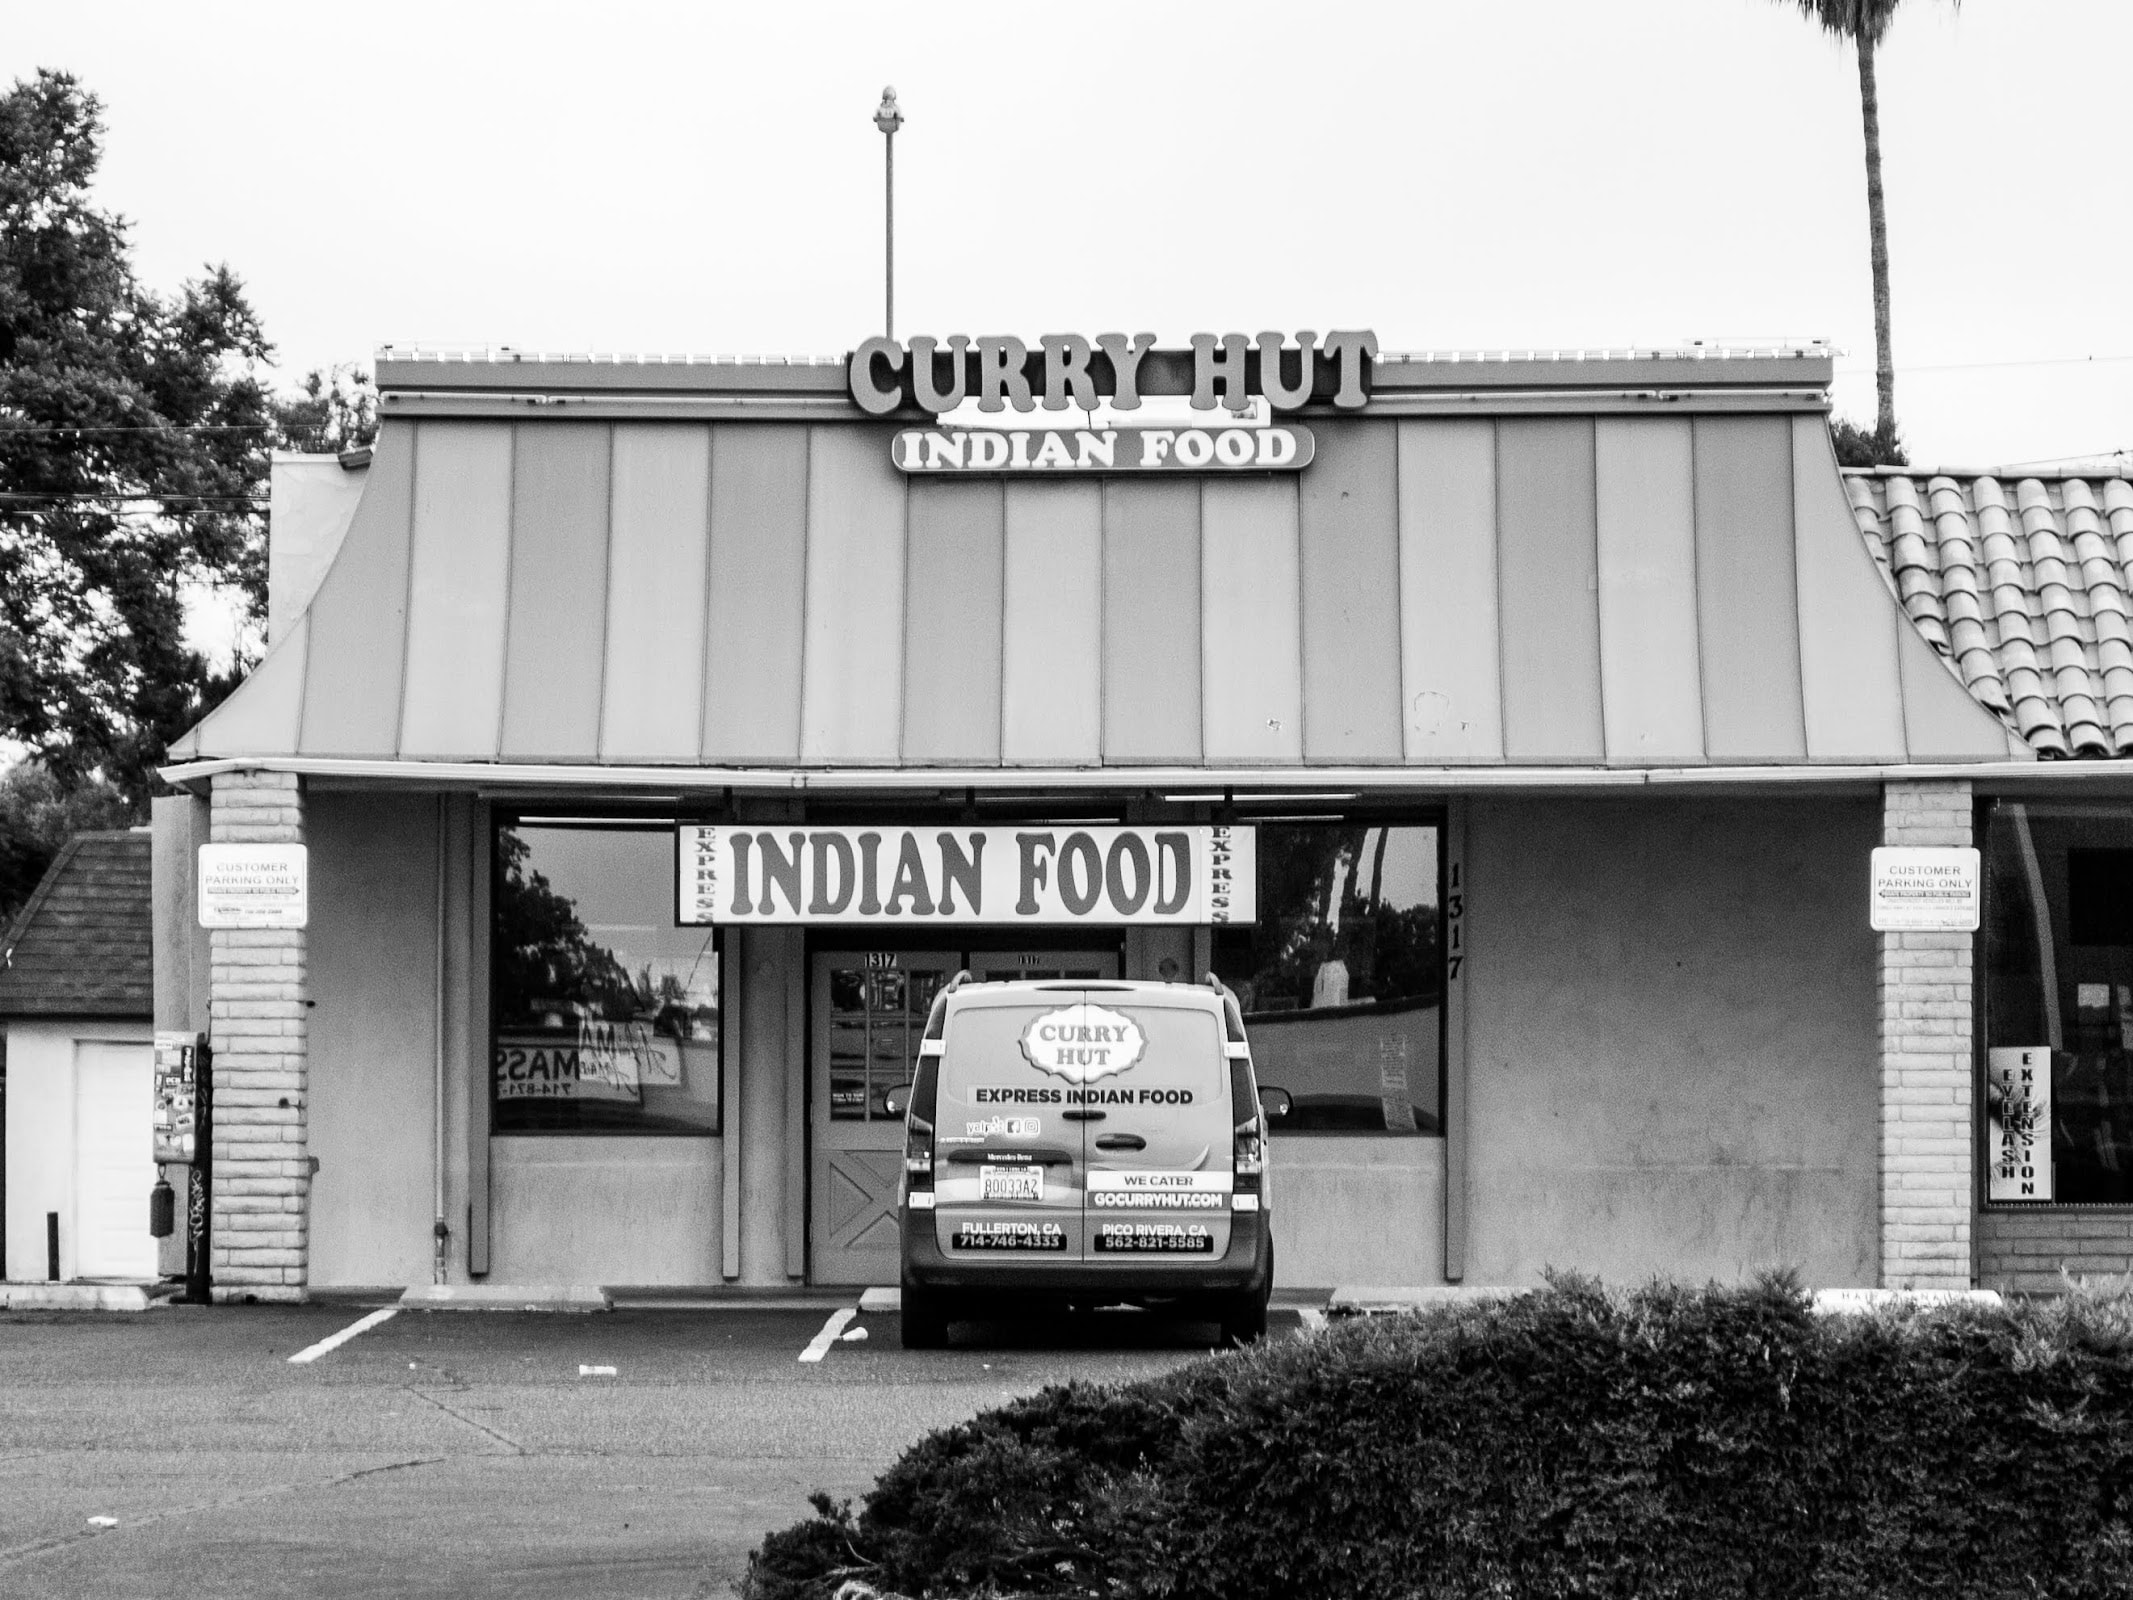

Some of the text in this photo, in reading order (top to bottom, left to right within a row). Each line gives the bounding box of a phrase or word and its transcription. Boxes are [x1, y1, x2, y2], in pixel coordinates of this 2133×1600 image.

[850, 329, 1378, 414] CURRY HUT
[901, 429, 1297, 468] INDIAN FOOD
[216, 862, 288, 872] CUSTOMER
[695, 826, 717, 924] EXPRESS
[728, 830, 1192, 916] INDIAN FOOD
[1209, 826, 1232, 924] EXPRESS
[1889, 865, 1961, 875] CUSTOMER
[205, 875, 299, 885] PARKING ONLY
[1878, 879, 1973, 888] PARKING ONLY
[1448, 863, 1464, 980] 1317
[866, 953, 896, 967] 1317
[1039, 1025, 1129, 1042] CURRY
[1056, 1048, 1111, 1065] HUT
[976, 1089, 1193, 1104] EXPRESS INDIAN FOOD
[2002, 1069, 2015, 1179] EYELASH
[2021, 1052, 2034, 1195] EXTENSION
[1124, 1176, 1193, 1186] WE CATER
[1095, 1193, 1223, 1208] GOCURRYHUT.COM
[962, 1222, 1062, 1236] FULLERTON, CA
[1102, 1223, 1208, 1239] PICO RIVERA, CA
[960, 1234, 1060, 1247] 714-746-4333
